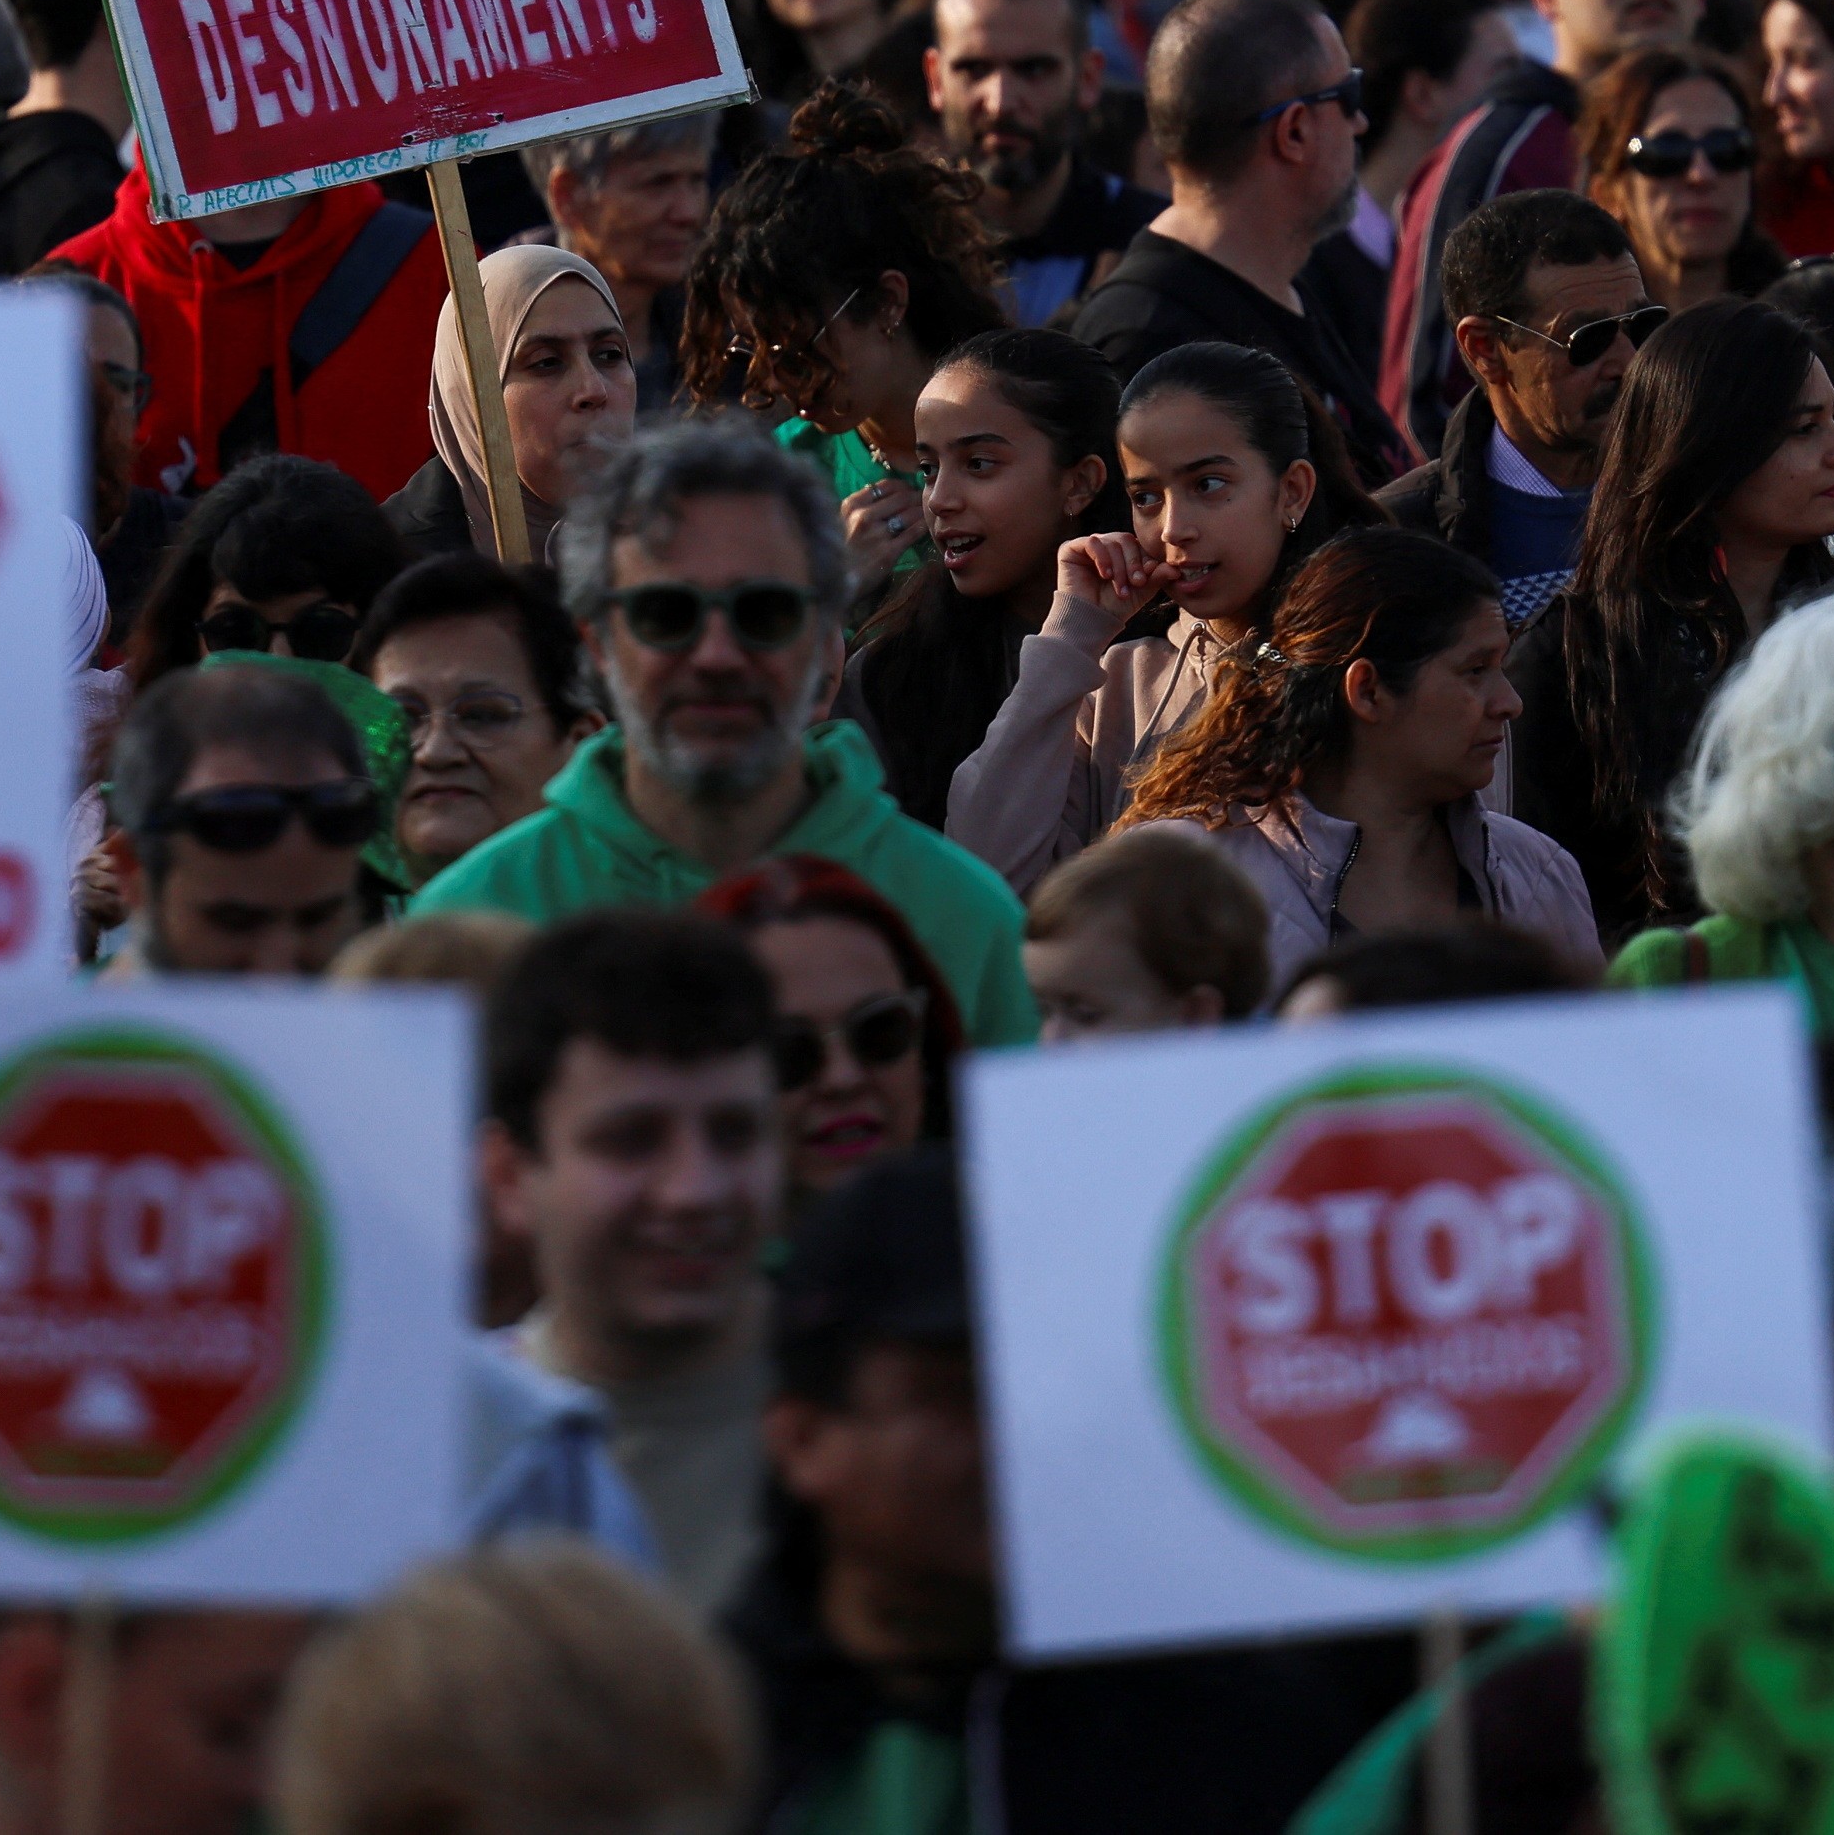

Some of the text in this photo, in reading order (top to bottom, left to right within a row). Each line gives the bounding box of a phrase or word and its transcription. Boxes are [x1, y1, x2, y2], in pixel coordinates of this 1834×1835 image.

[204, 173, 297, 213] AFECTATS
[311, 148, 403, 188] HIPOTECA
[1227, 1170, 1581, 1337] STOP
